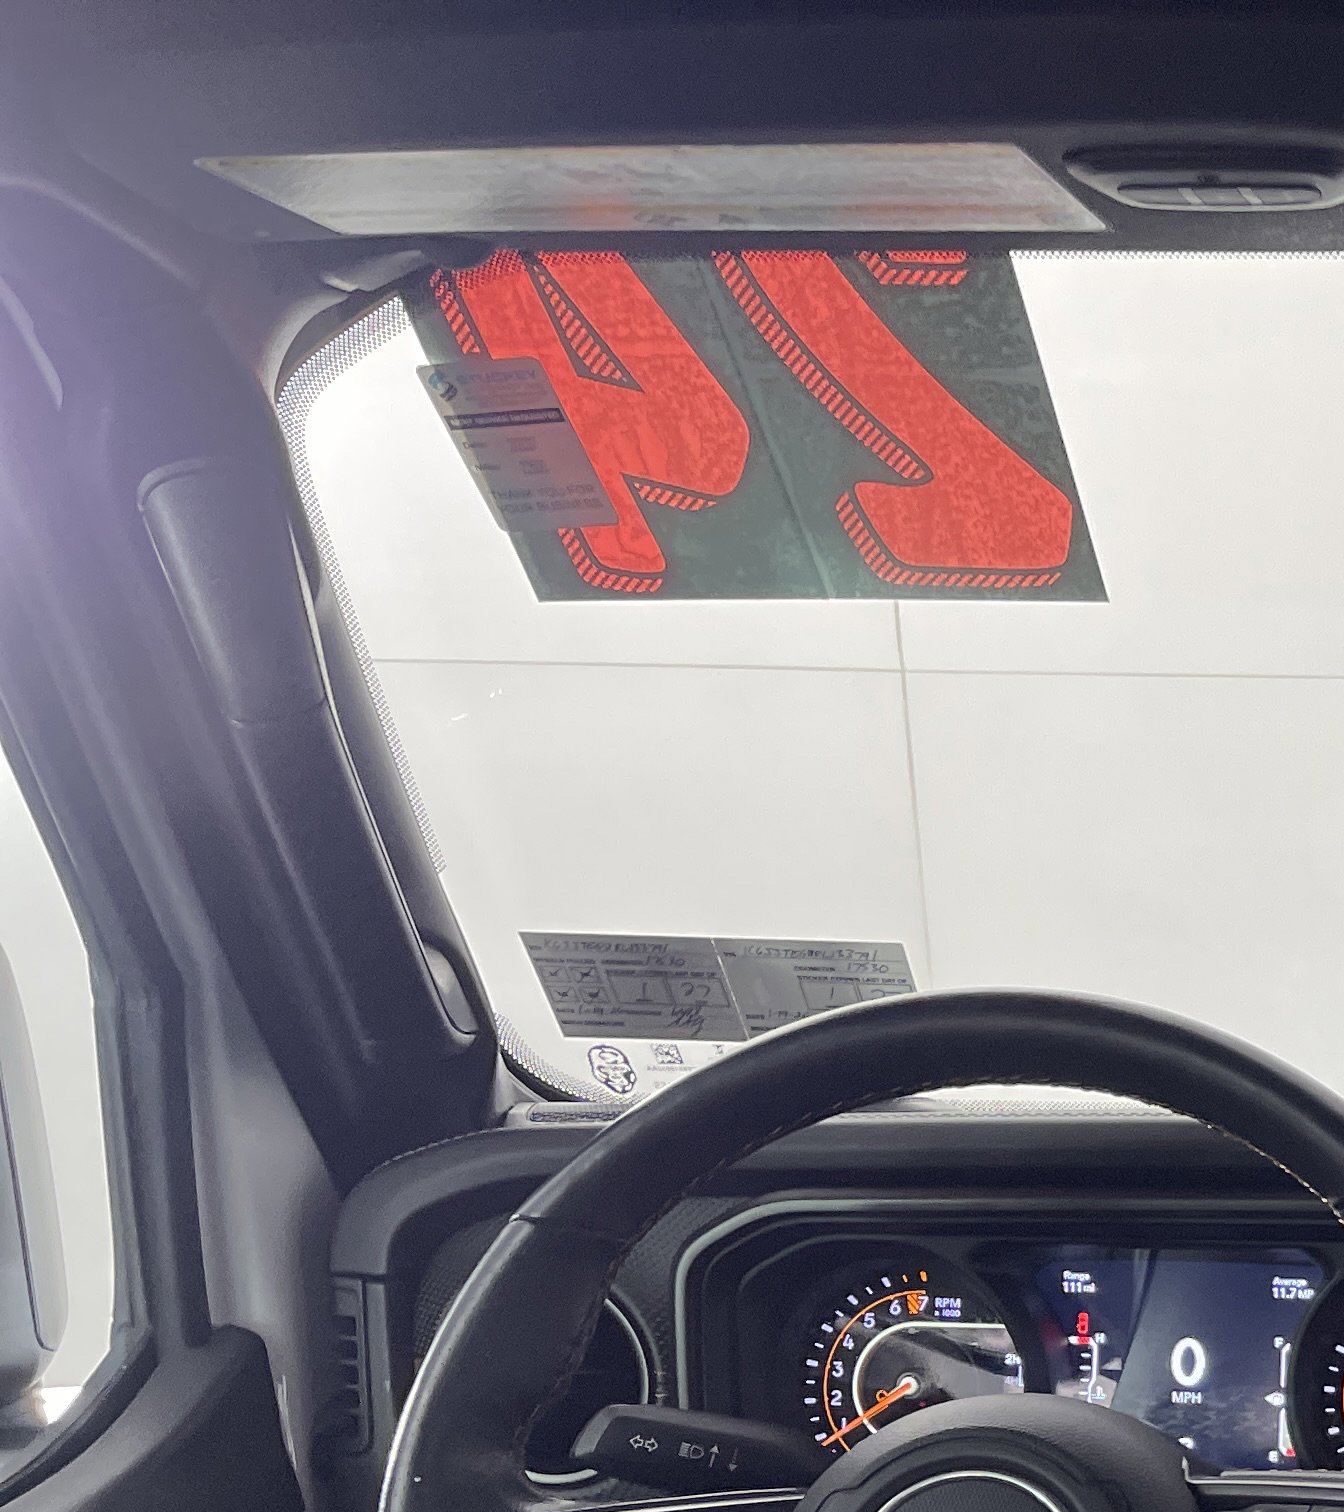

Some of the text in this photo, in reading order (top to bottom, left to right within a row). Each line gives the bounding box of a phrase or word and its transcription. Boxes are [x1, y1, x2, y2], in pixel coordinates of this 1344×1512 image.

[1063, 1270, 1090, 1282] Range
[1273, 1276, 1308, 1288] Average
[1272, 1287, 1297, 1299] 11.7
[889, 1301, 901, 1316] 6
[918, 1296, 929, 1311] 7
[934, 1297, 962, 1309] RPM
[863, 1313, 876, 1328] 5
[842, 1334, 854, 1350] 4
[832, 1361, 844, 1377] 3
[1170, 1337, 1207, 1386] 0
[830, 1390, 842, 1407] 2
[1171, 1391, 1201, 1404] MPH
